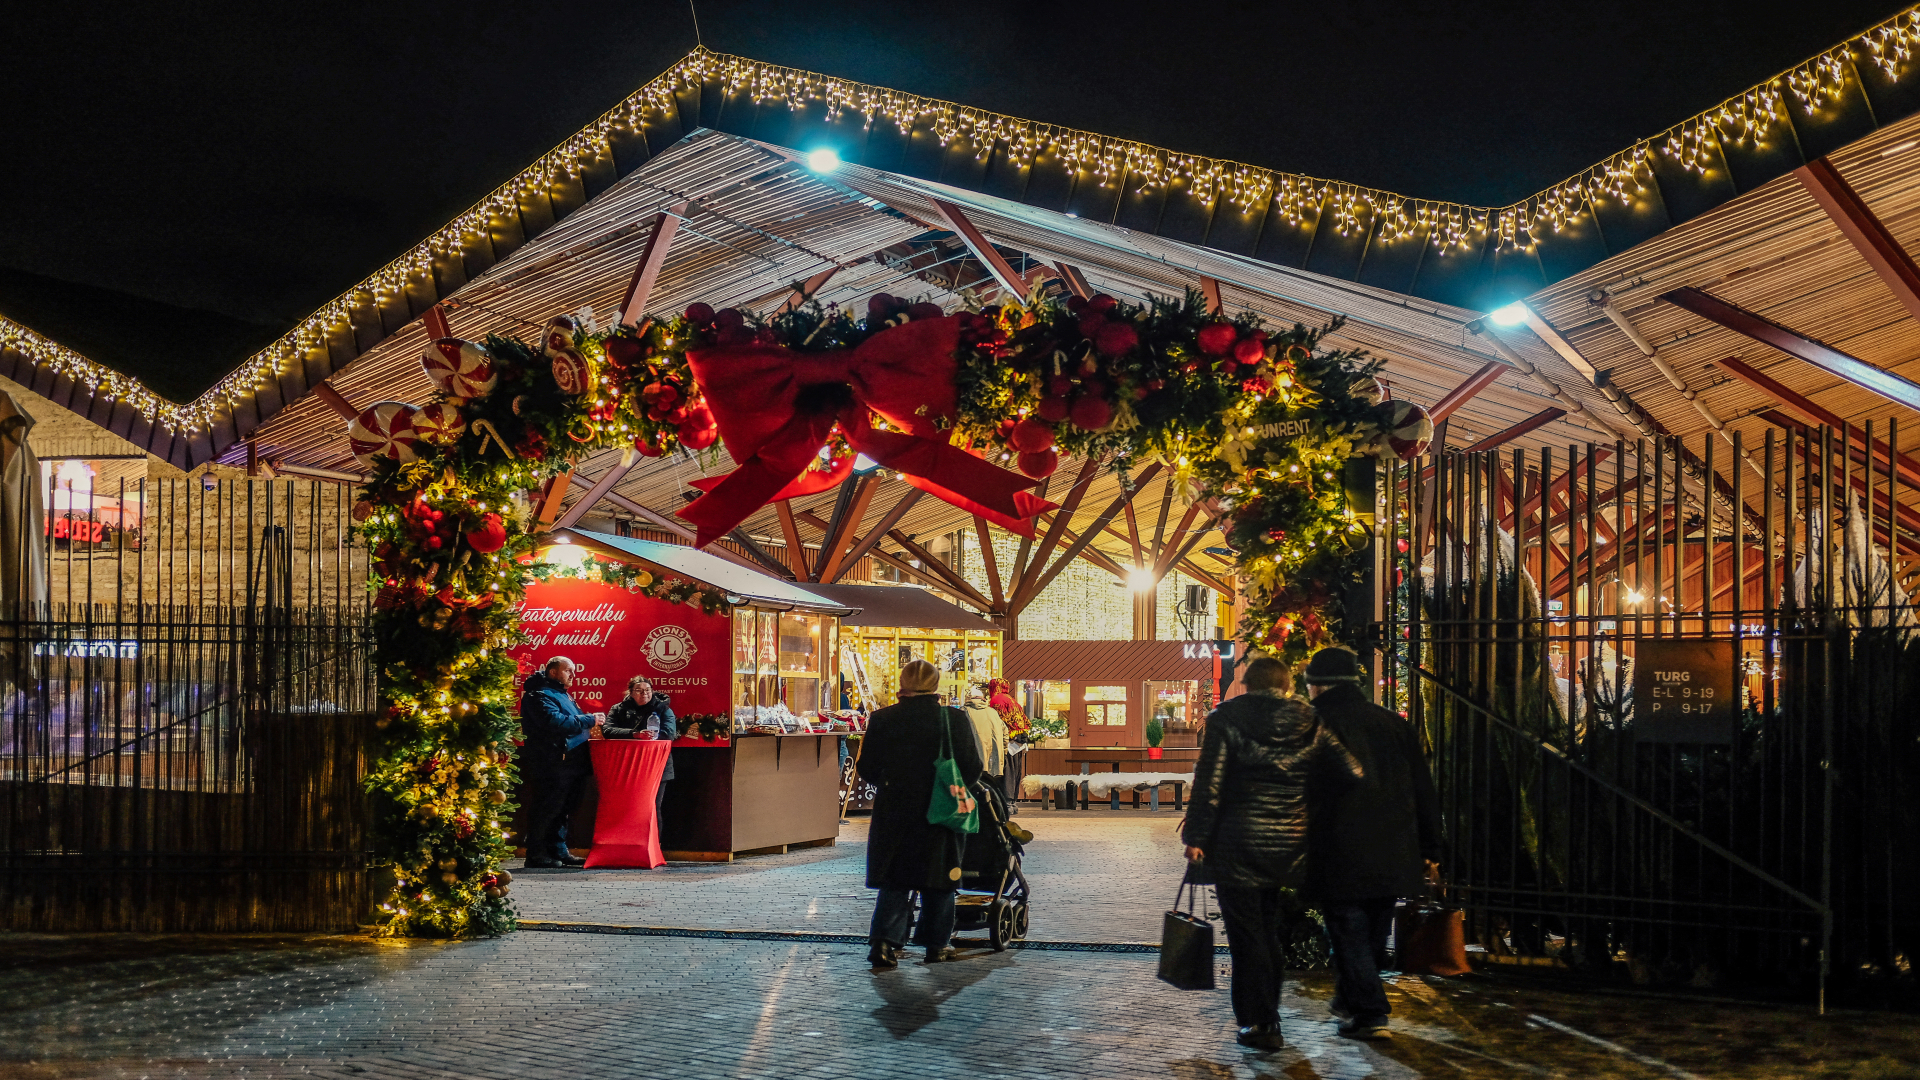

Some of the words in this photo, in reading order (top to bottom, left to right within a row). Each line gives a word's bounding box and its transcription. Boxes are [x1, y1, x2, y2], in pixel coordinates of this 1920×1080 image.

[553, 624, 615, 648] müük!
[652, 627, 686, 638] LIONS
[663, 639, 677, 656] L
[1654, 671, 1691, 682] TURG
[1653, 687, 1674, 698] E-L
[1652, 702, 1662, 713] P
